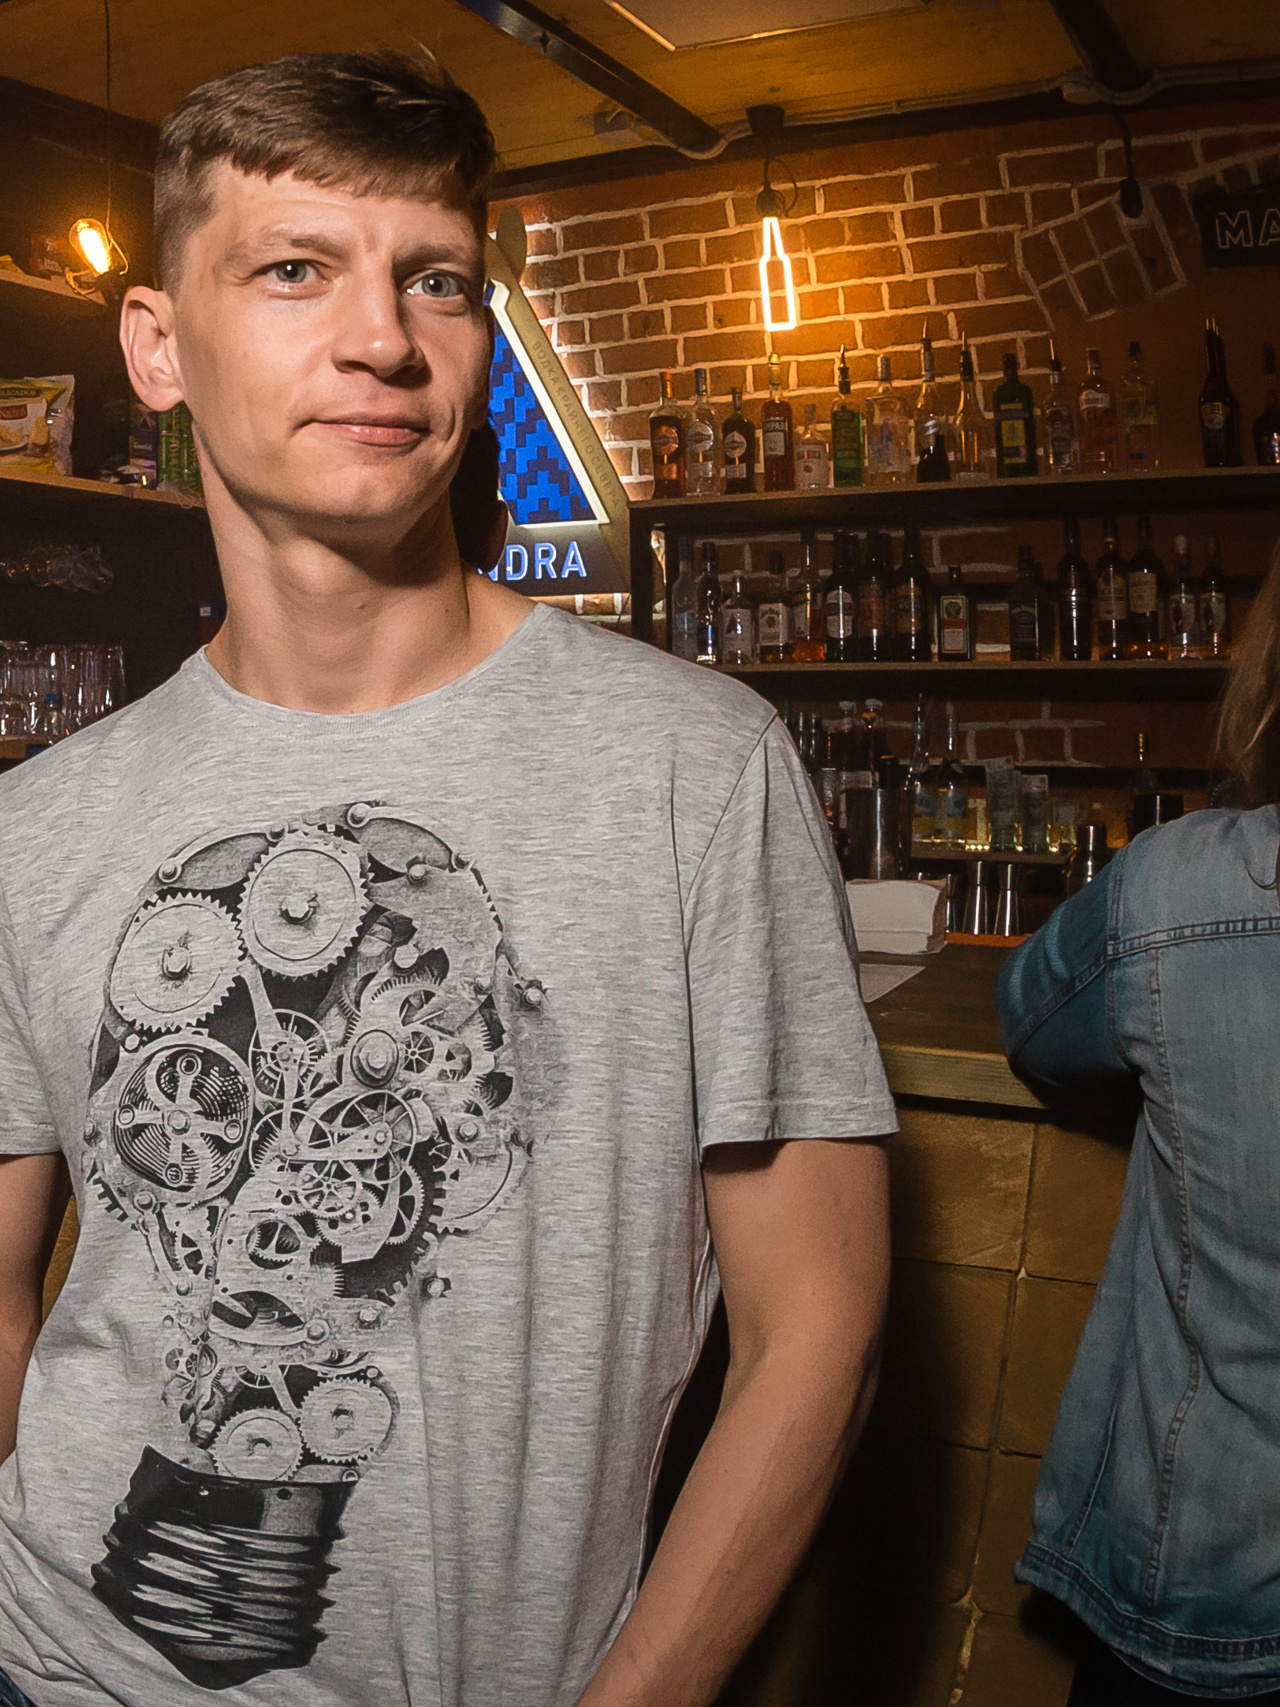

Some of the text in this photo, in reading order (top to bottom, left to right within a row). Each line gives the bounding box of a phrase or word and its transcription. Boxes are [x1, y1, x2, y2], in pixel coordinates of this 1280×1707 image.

[533, 340, 560, 386] ВОДКА
[590, 454, 621, 507] СЕВЕРА
[477, 541, 587, 581] DRA
